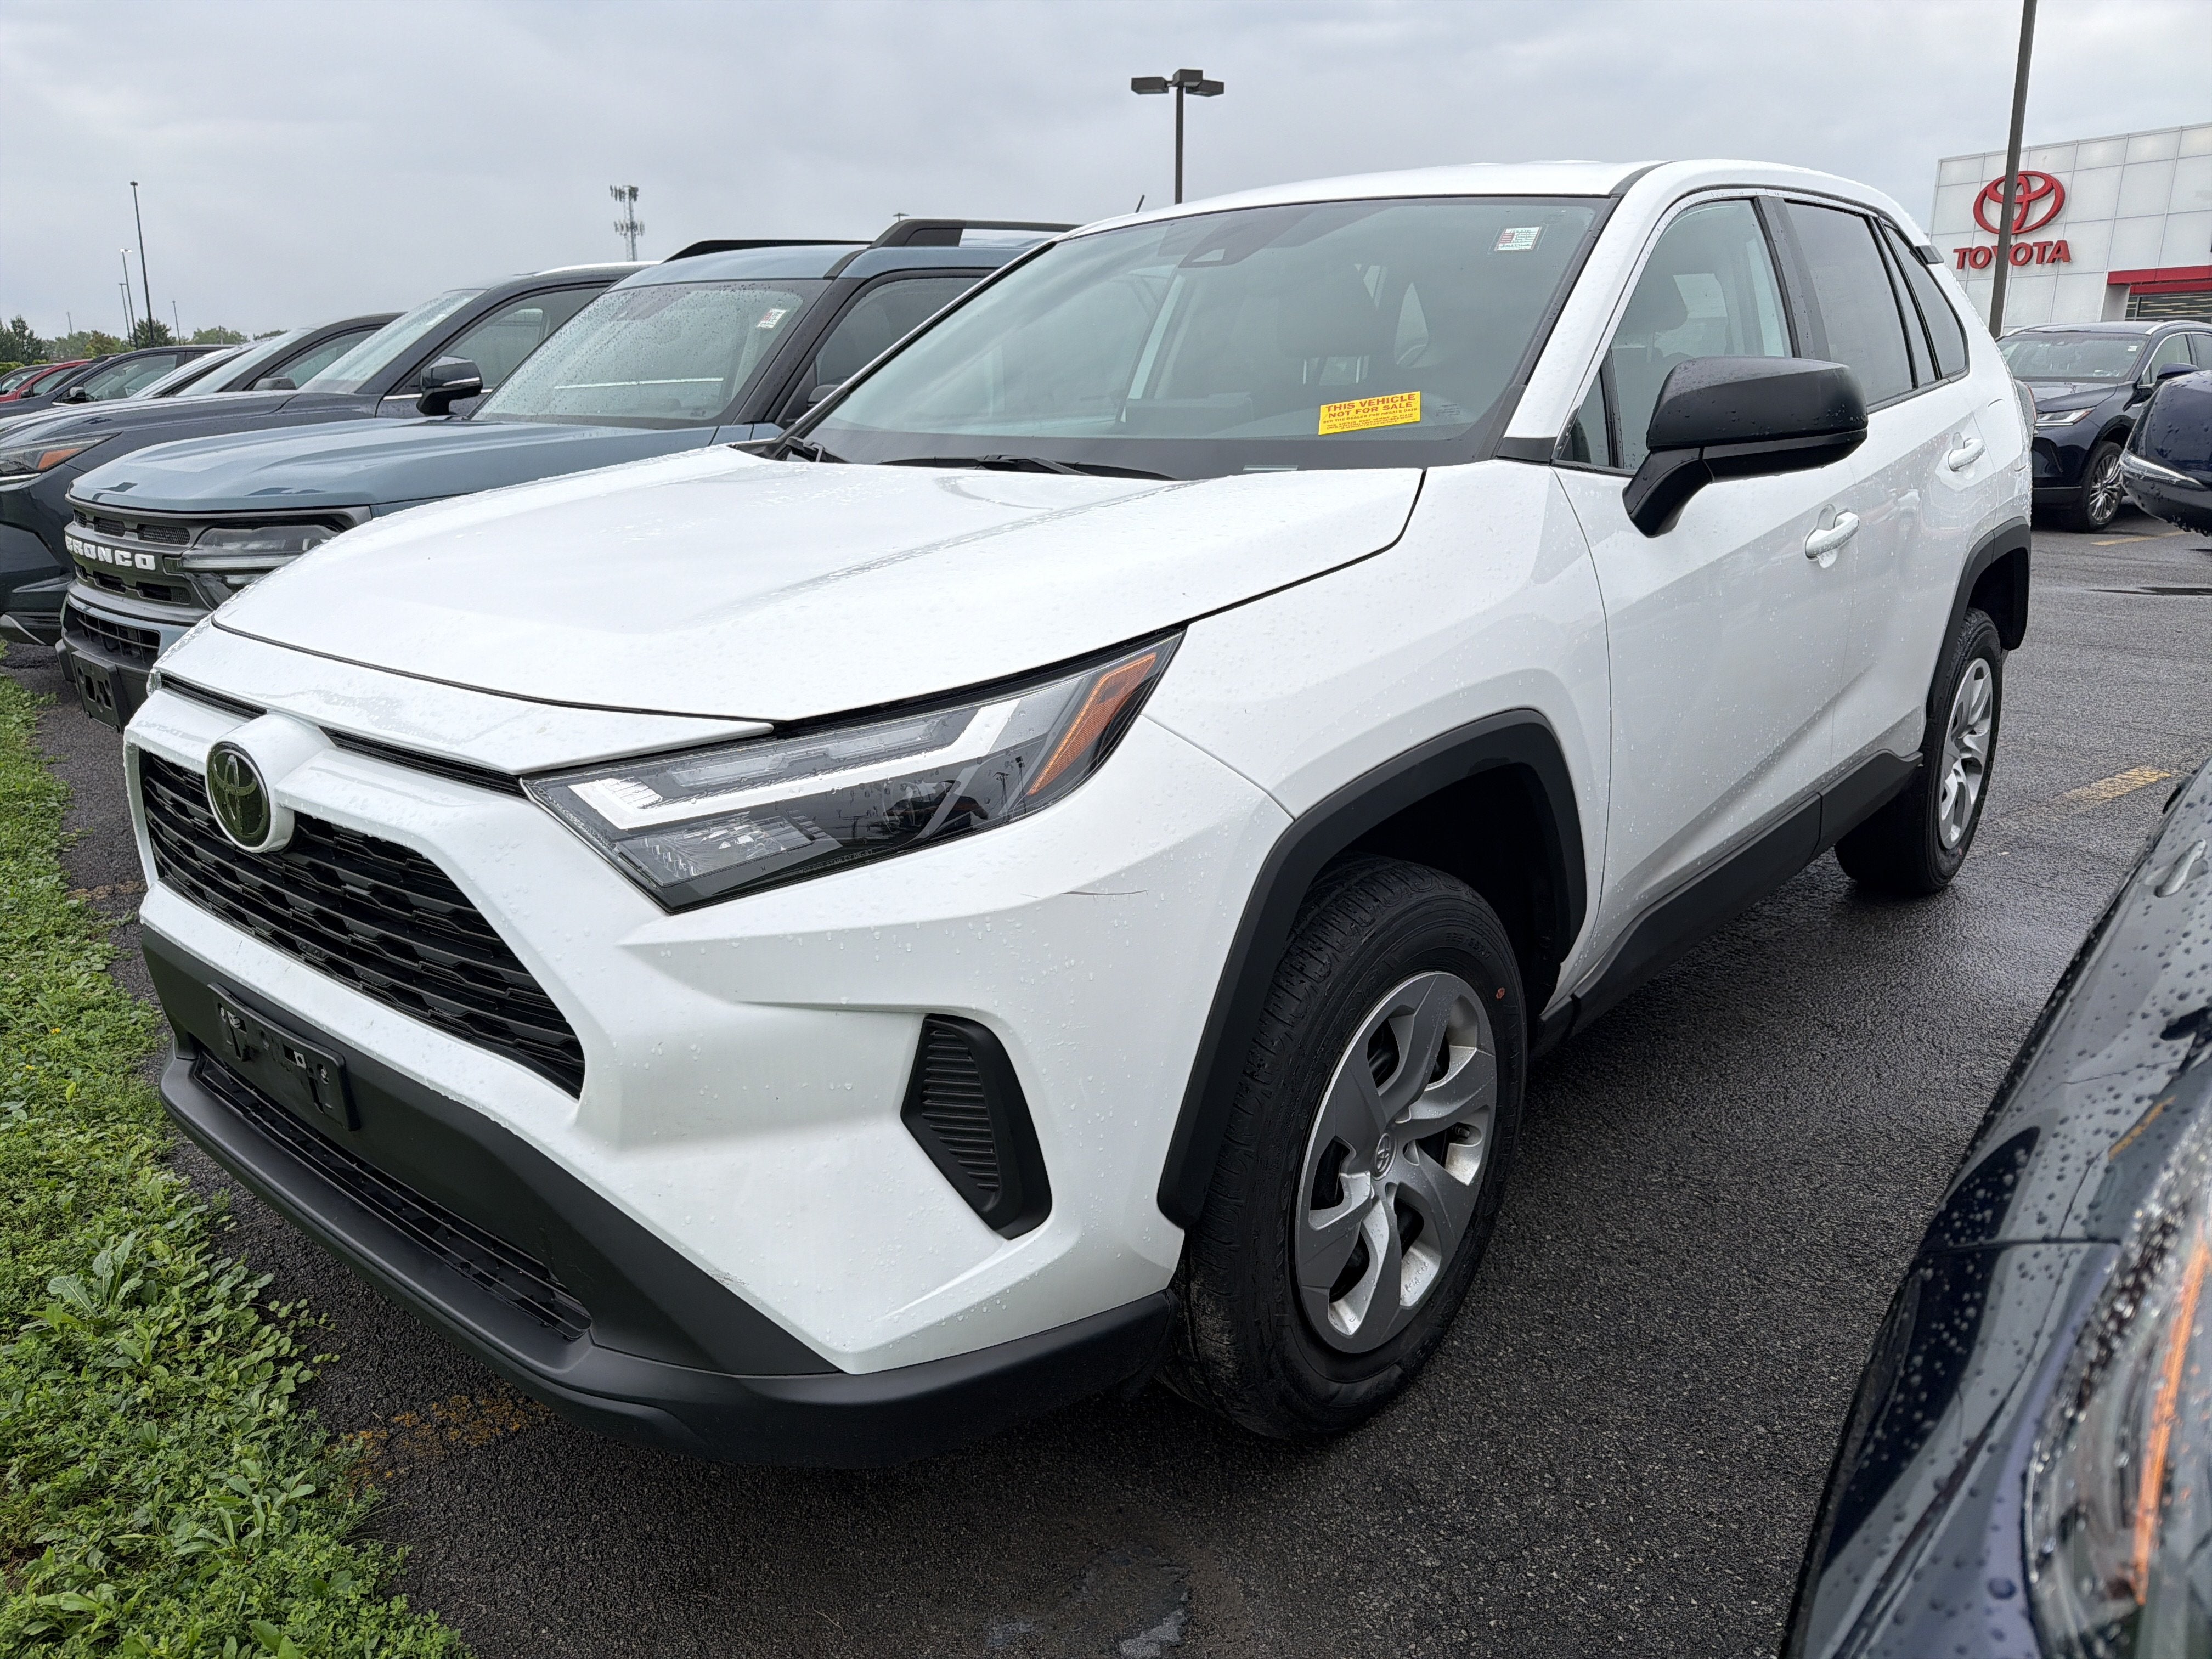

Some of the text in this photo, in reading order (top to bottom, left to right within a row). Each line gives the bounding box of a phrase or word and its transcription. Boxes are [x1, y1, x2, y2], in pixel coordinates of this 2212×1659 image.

[1326, 394, 1415, 412] THIS VEHICLE
[1383, 402, 1412, 410] SALE
[65, 535, 156, 571] BRONCO
[826, 855, 852, 867] STANLEY
